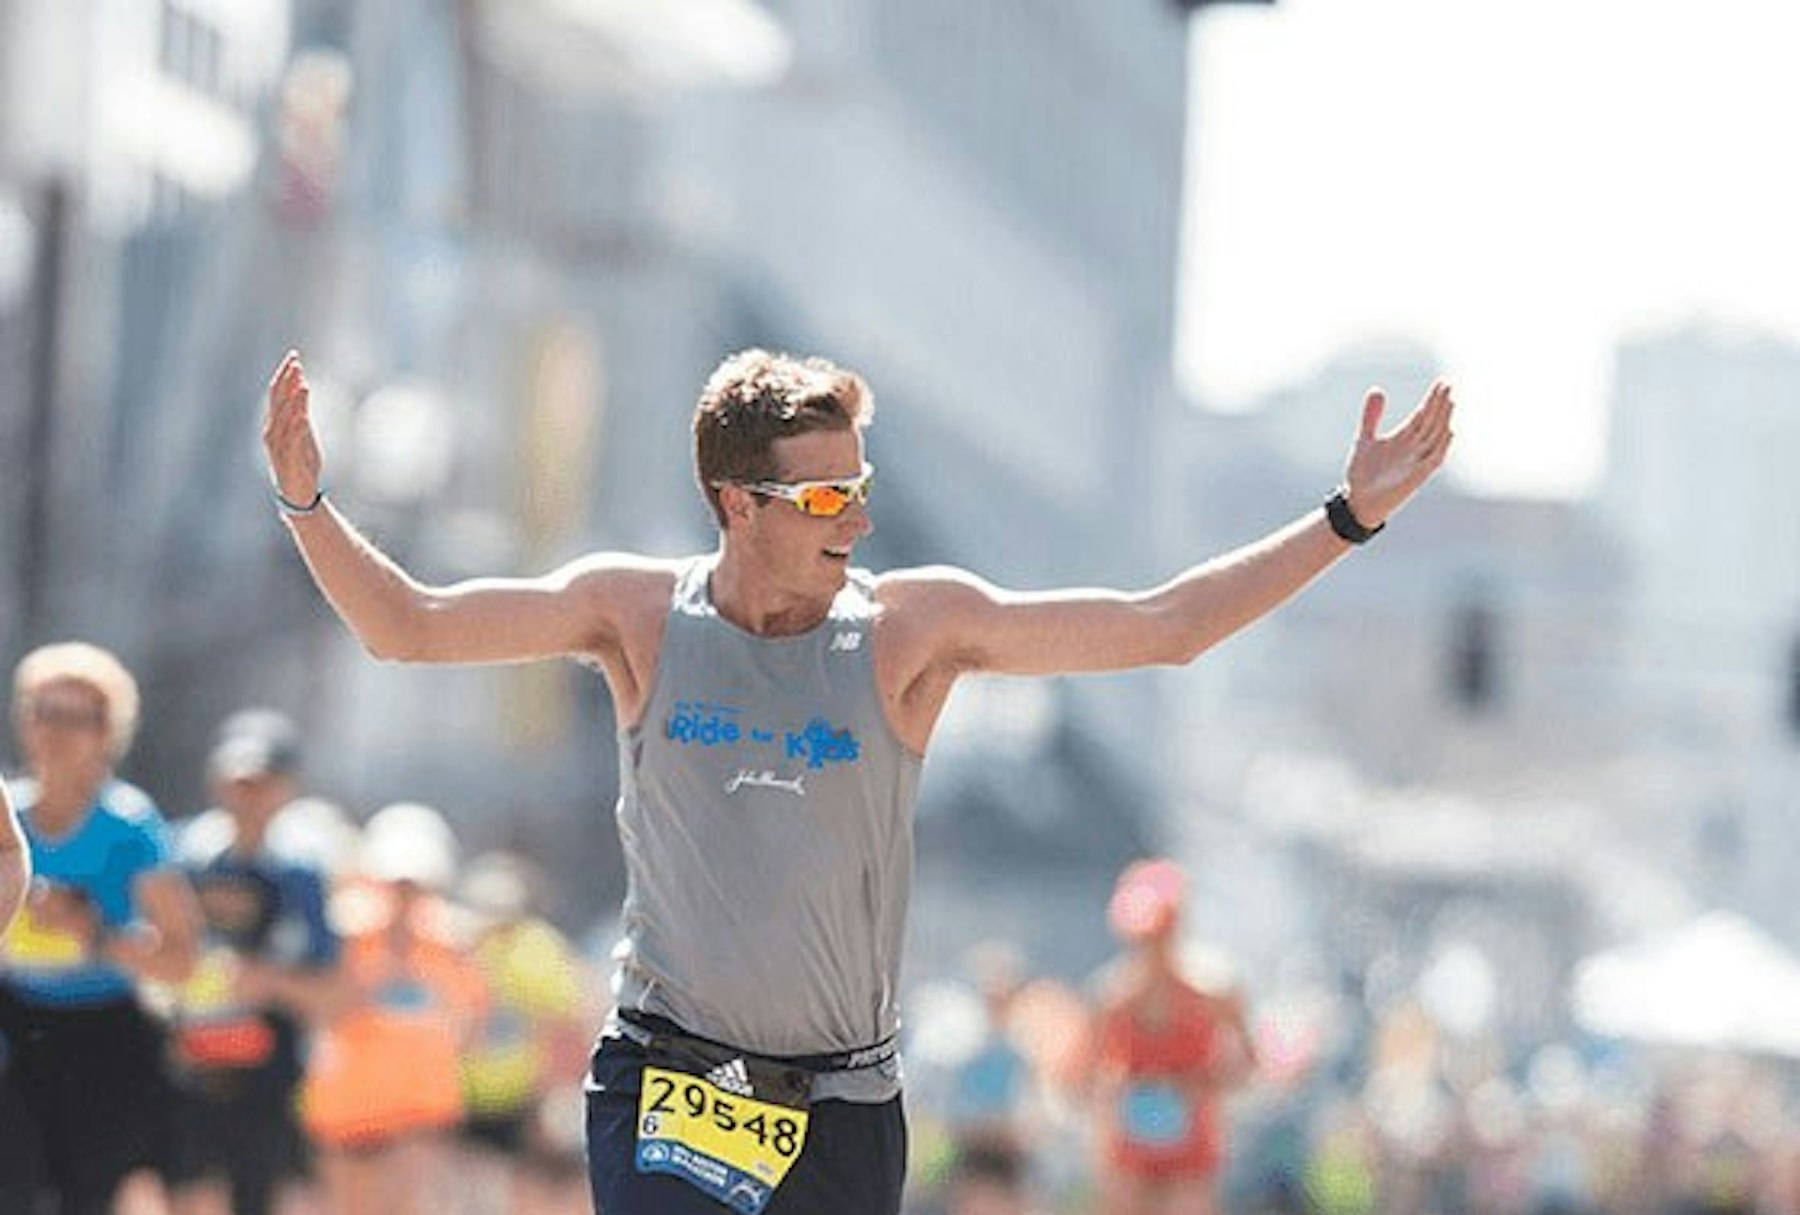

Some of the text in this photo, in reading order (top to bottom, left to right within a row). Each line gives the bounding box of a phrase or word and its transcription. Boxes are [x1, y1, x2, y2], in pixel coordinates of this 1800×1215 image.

[667, 714, 740, 745] Ride
[643, 1115, 658, 1134] 6
[648, 1077, 797, 1156] 29548
